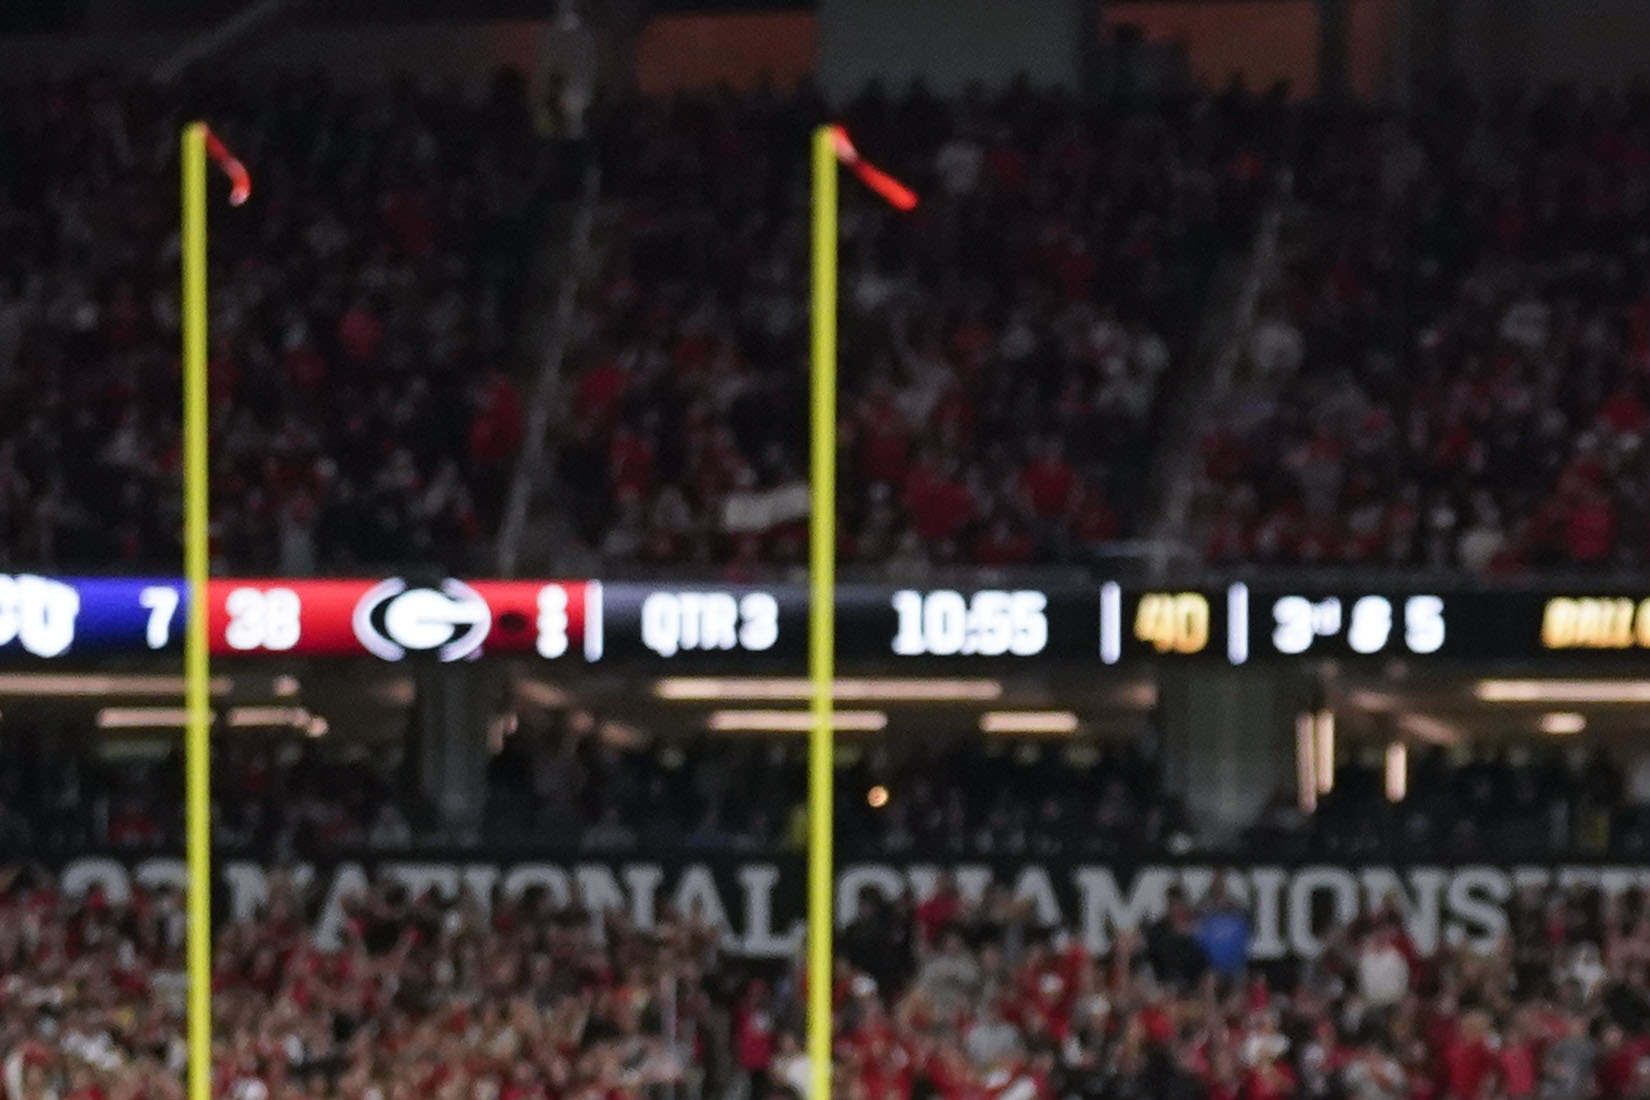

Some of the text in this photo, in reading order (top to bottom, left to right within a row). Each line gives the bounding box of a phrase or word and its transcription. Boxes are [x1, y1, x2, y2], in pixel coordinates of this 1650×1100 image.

[139, 586, 179, 649] 7
[642, 592, 778, 656] QTR 3
[894, 590, 1047, 655] 10:55
[1136, 593, 1208, 652] 40
[1405, 596, 1444, 653] 5
[1543, 598, 1634, 648] BALL
